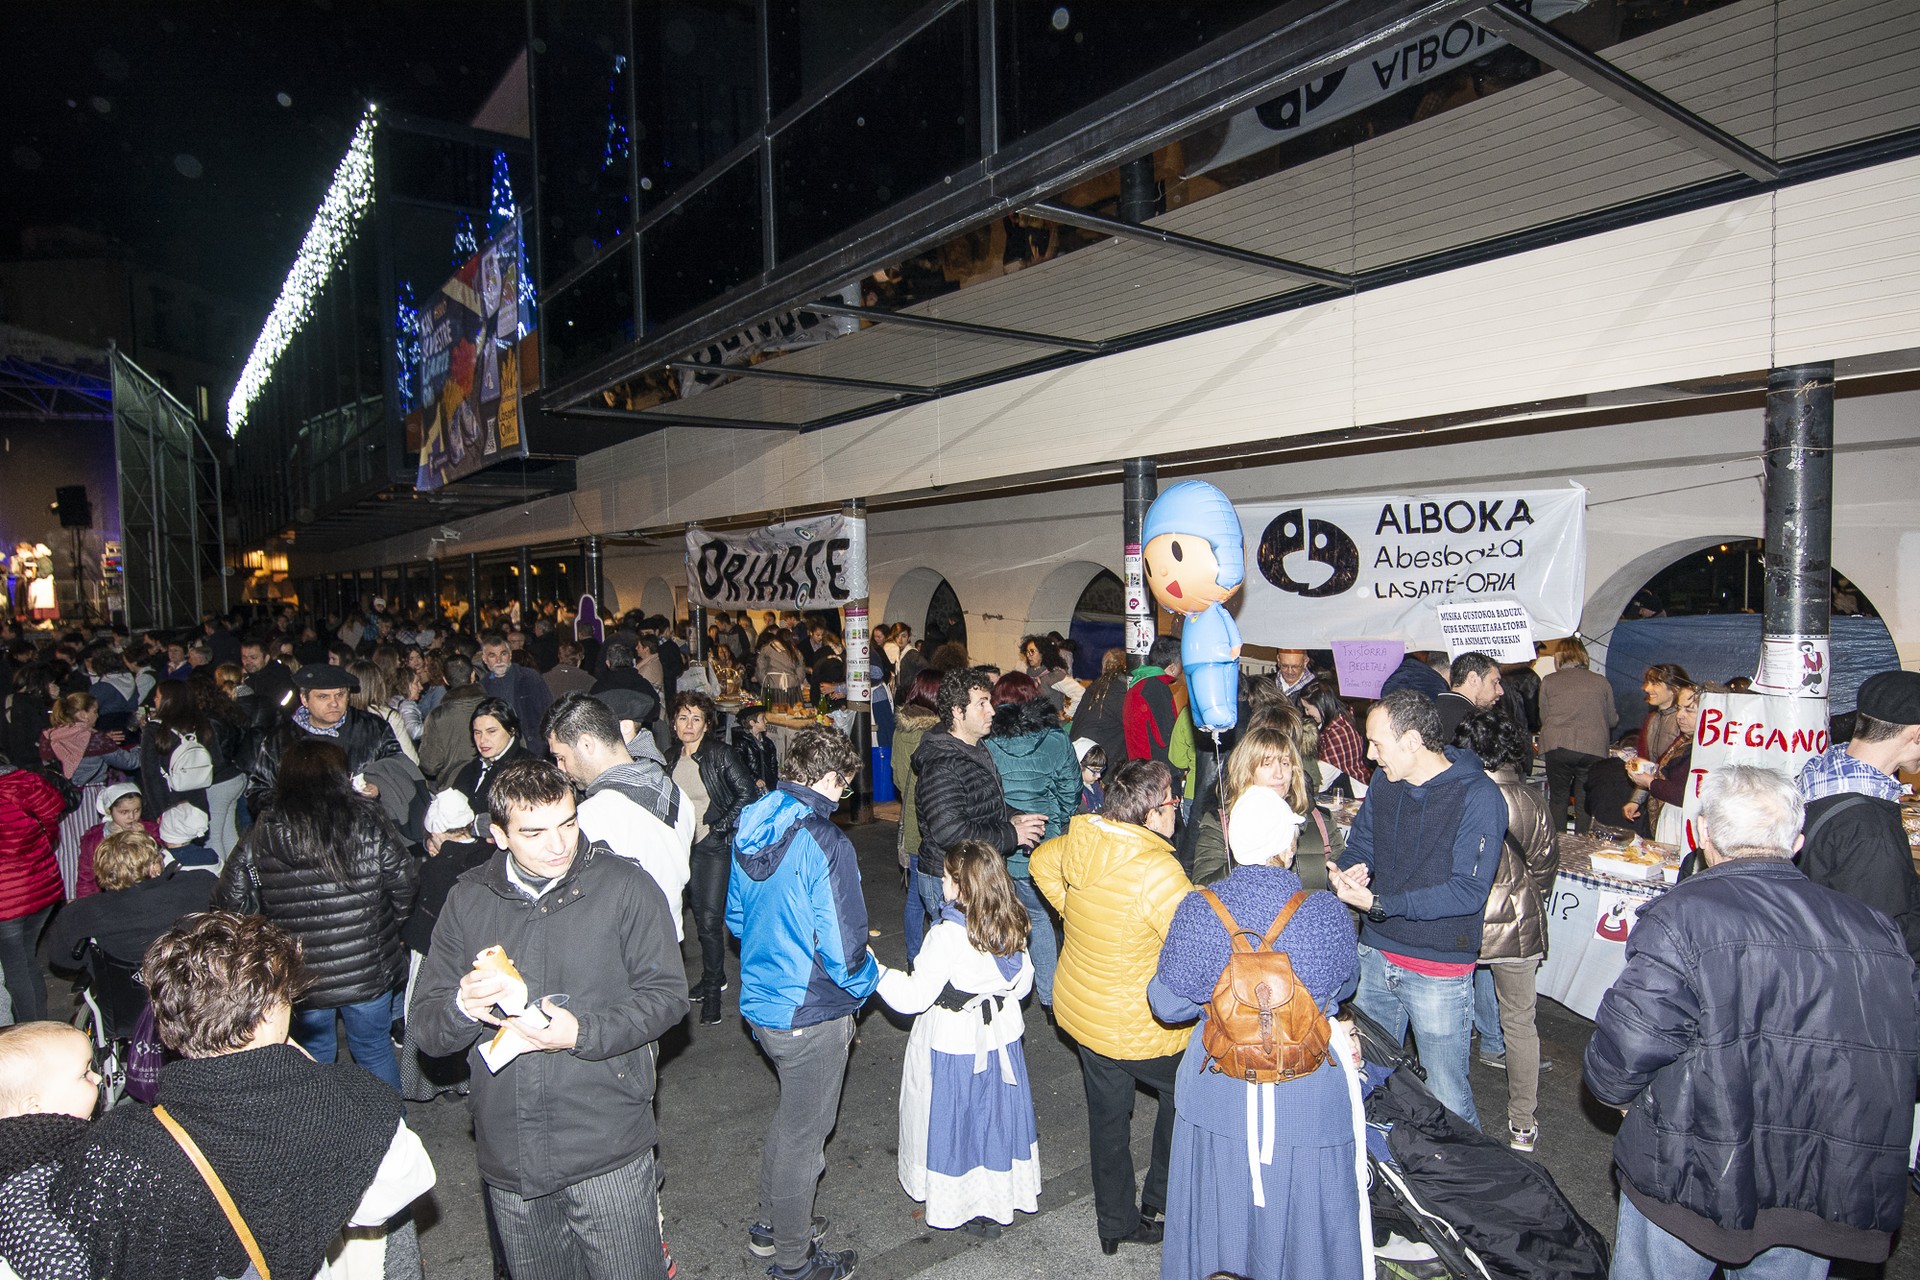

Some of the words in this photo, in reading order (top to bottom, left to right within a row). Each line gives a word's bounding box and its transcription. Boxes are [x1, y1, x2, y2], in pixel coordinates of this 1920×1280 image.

[1375, 499, 1534, 535] ALBOKA
[698, 538, 850, 601] ORIARTE
[1462, 610, 1496, 620] GUSTOKOA
[1503, 620, 1528, 631] ETORRI
[1452, 637, 1464, 646] ETA
[1465, 636, 1491, 645] ANIMATU
[1491, 634, 1521, 645] GUREKIN
